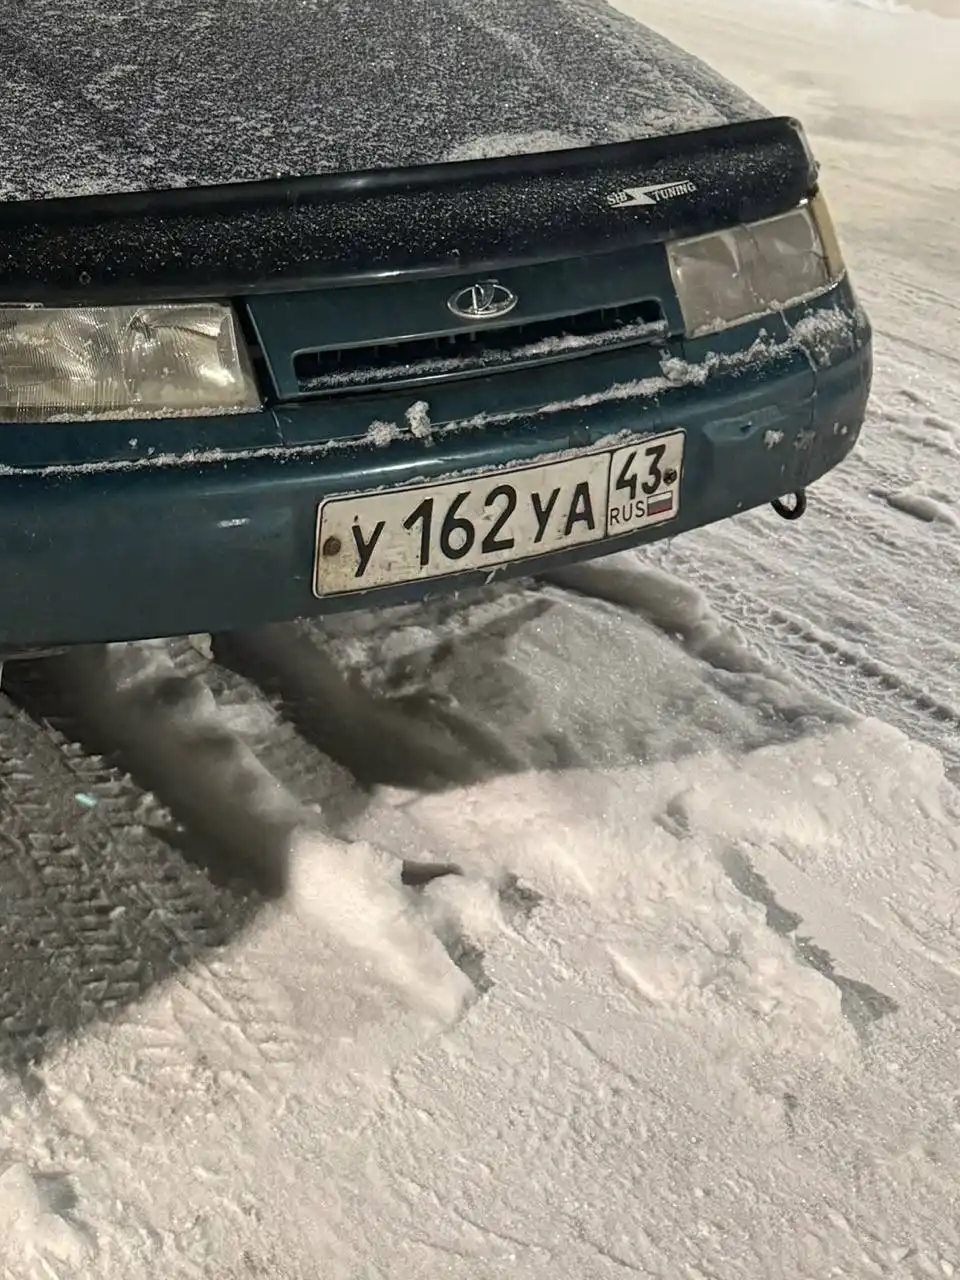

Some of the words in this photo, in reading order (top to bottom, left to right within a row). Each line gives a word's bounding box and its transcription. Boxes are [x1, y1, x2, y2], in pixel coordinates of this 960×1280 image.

[651, 181, 697, 201] TUNING
[615, 443, 666, 500] 43
[609, 500, 646, 526] RUS
